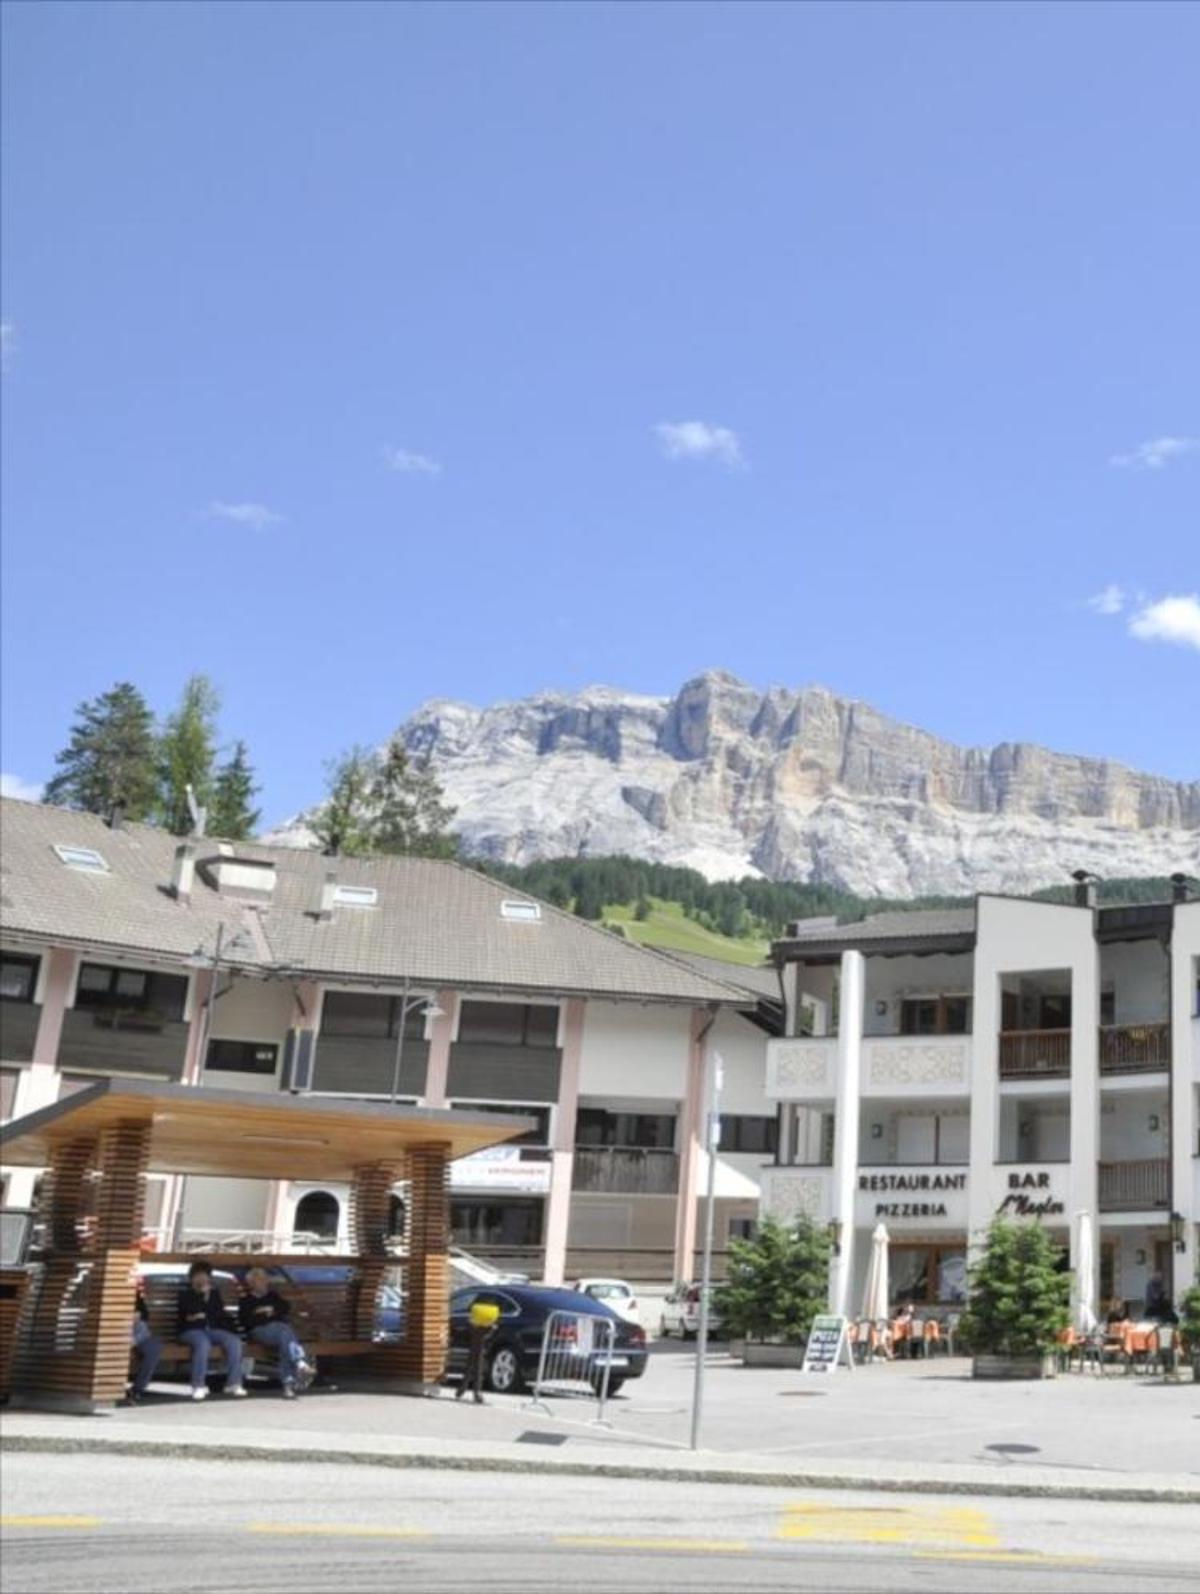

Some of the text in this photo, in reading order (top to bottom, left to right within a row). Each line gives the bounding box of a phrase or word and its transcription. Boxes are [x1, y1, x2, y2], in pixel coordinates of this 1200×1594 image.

[858, 1174, 966, 1191] RESTAURANT
[1008, 1172, 1050, 1189] BAR
[875, 1203, 947, 1217] PIZZERIA
